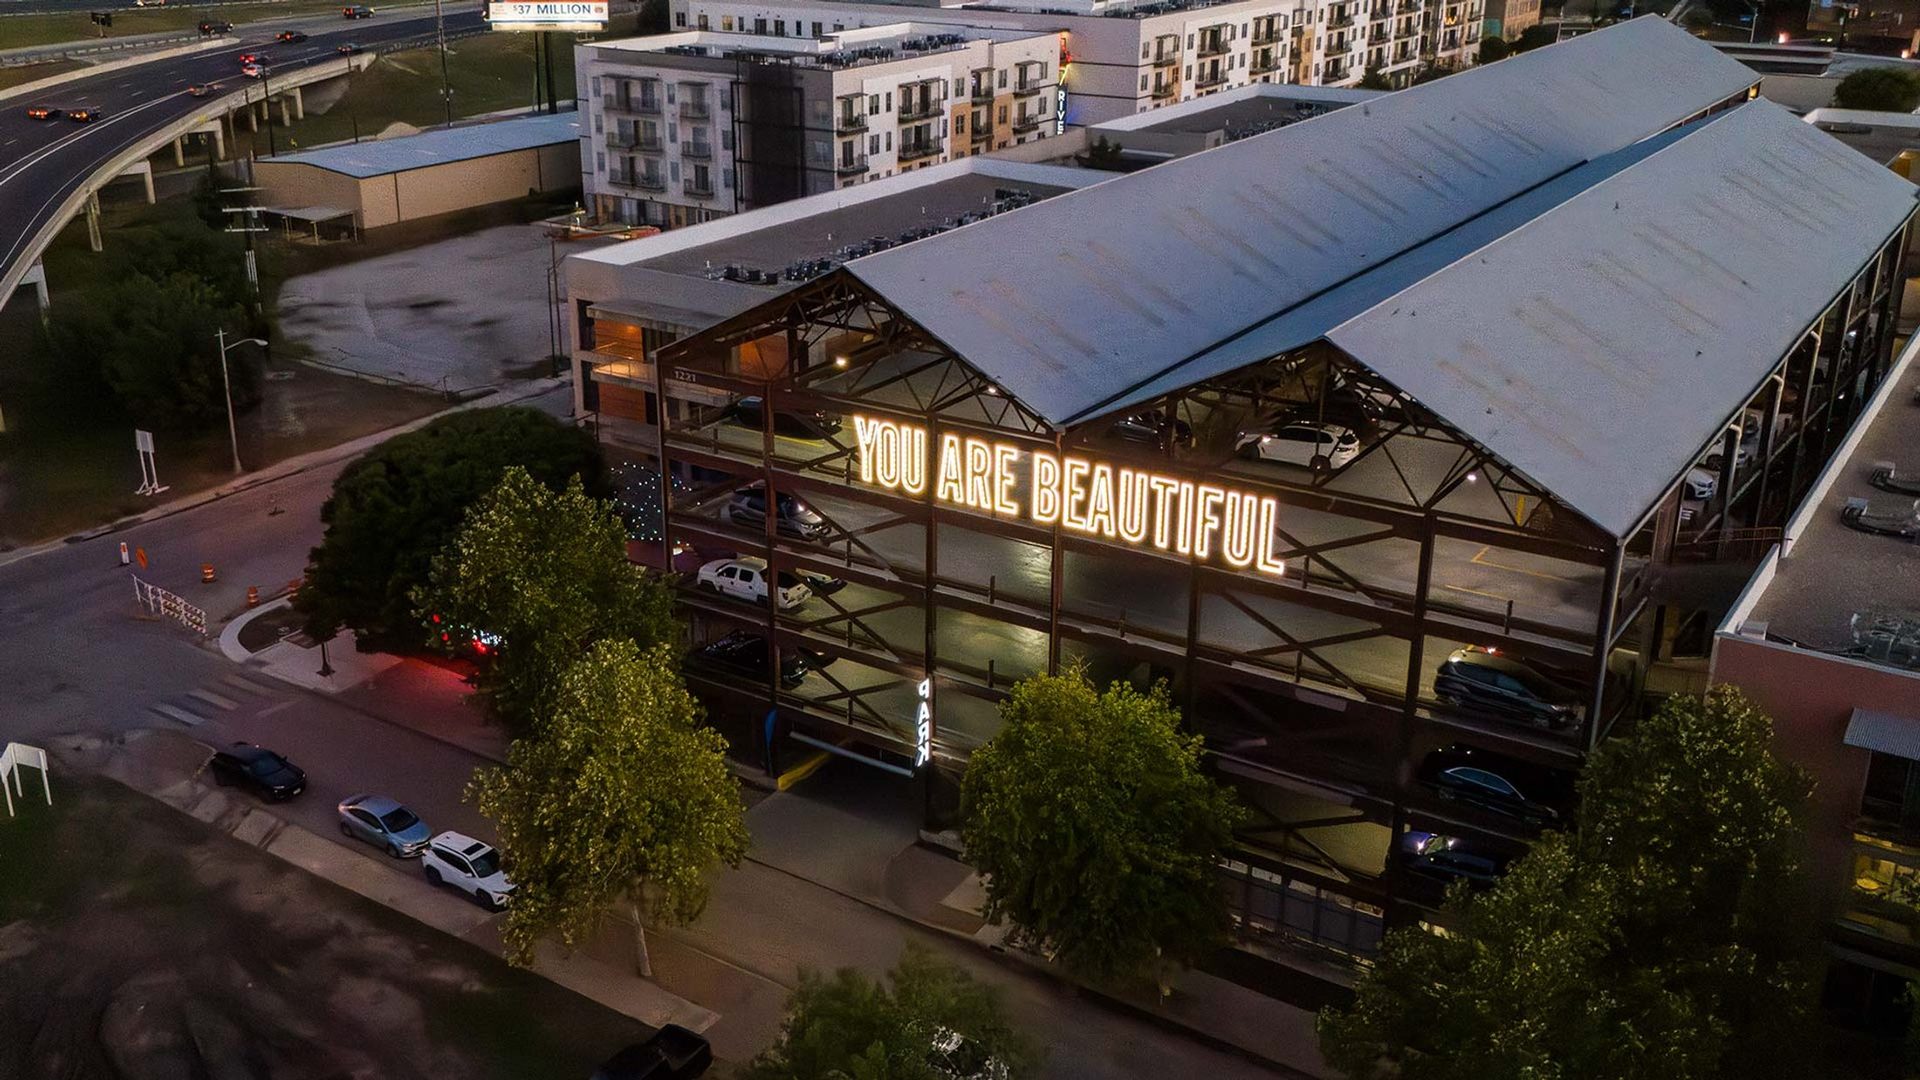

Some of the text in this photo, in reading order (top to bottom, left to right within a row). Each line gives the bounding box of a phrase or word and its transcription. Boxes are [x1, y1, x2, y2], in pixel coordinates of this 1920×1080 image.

[537, 4, 591, 14] MILLION
[853, 415, 1285, 576] YOU ARE BEAUTIFUL
